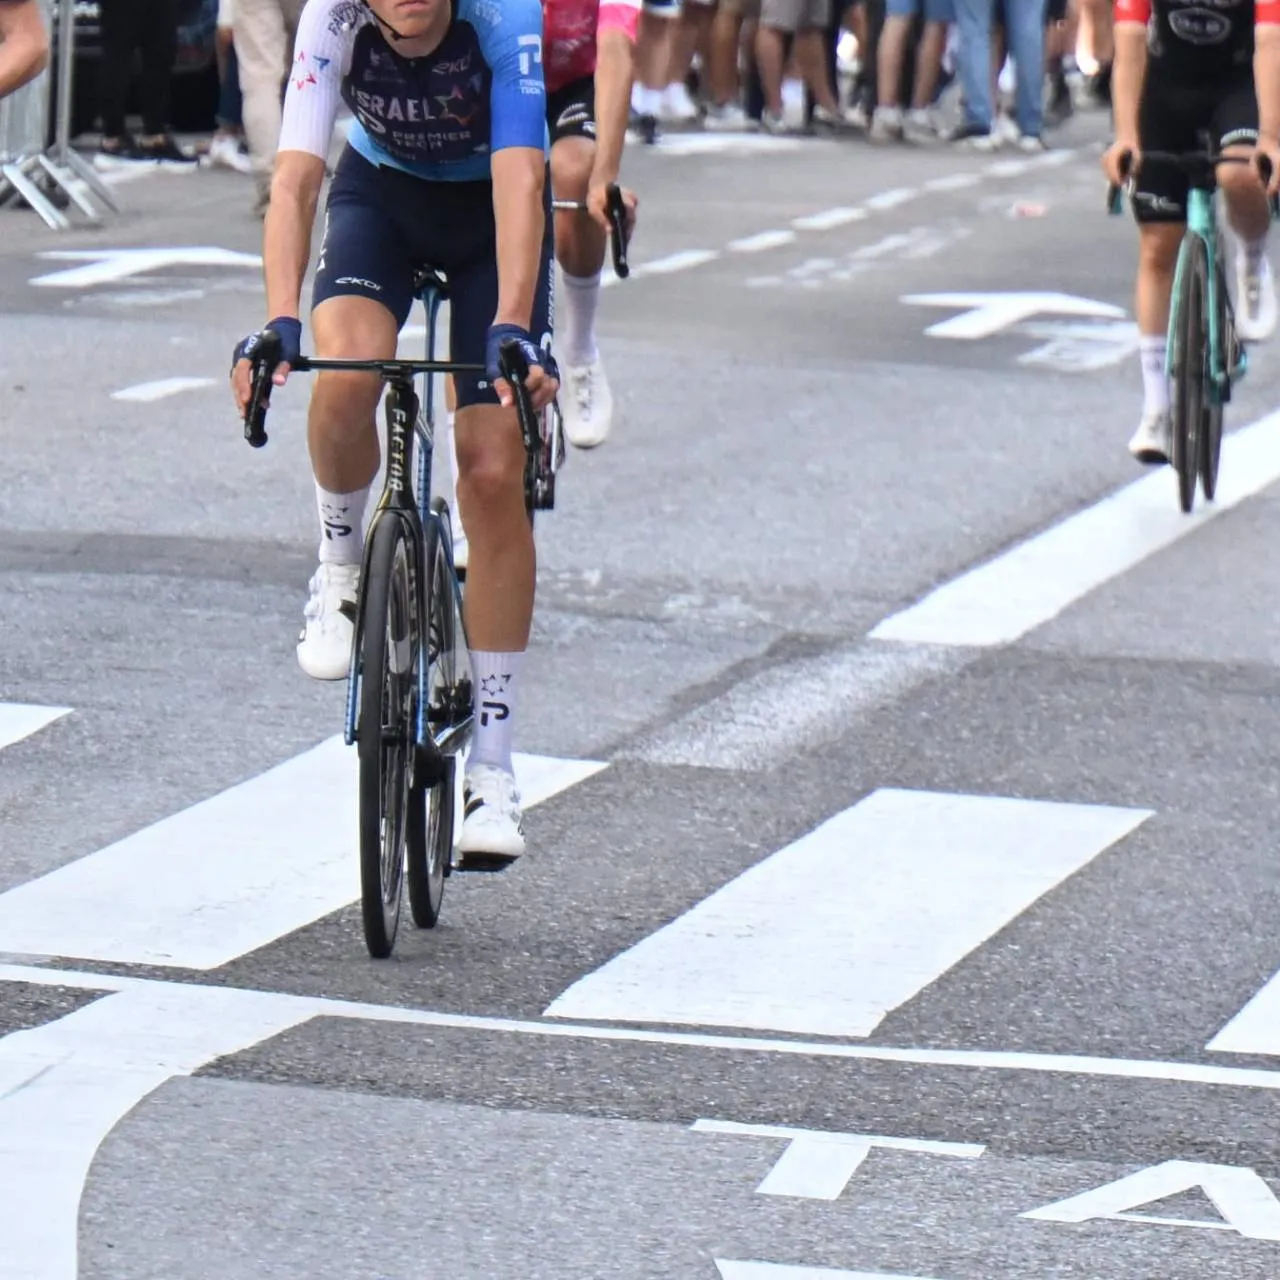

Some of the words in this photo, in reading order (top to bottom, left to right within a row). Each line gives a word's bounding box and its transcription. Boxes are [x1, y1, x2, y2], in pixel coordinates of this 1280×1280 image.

[350, 85, 436, 122] ISRAEL
[392, 130, 472, 143] PREMIER
[387, 408, 406, 493] FACTOR
